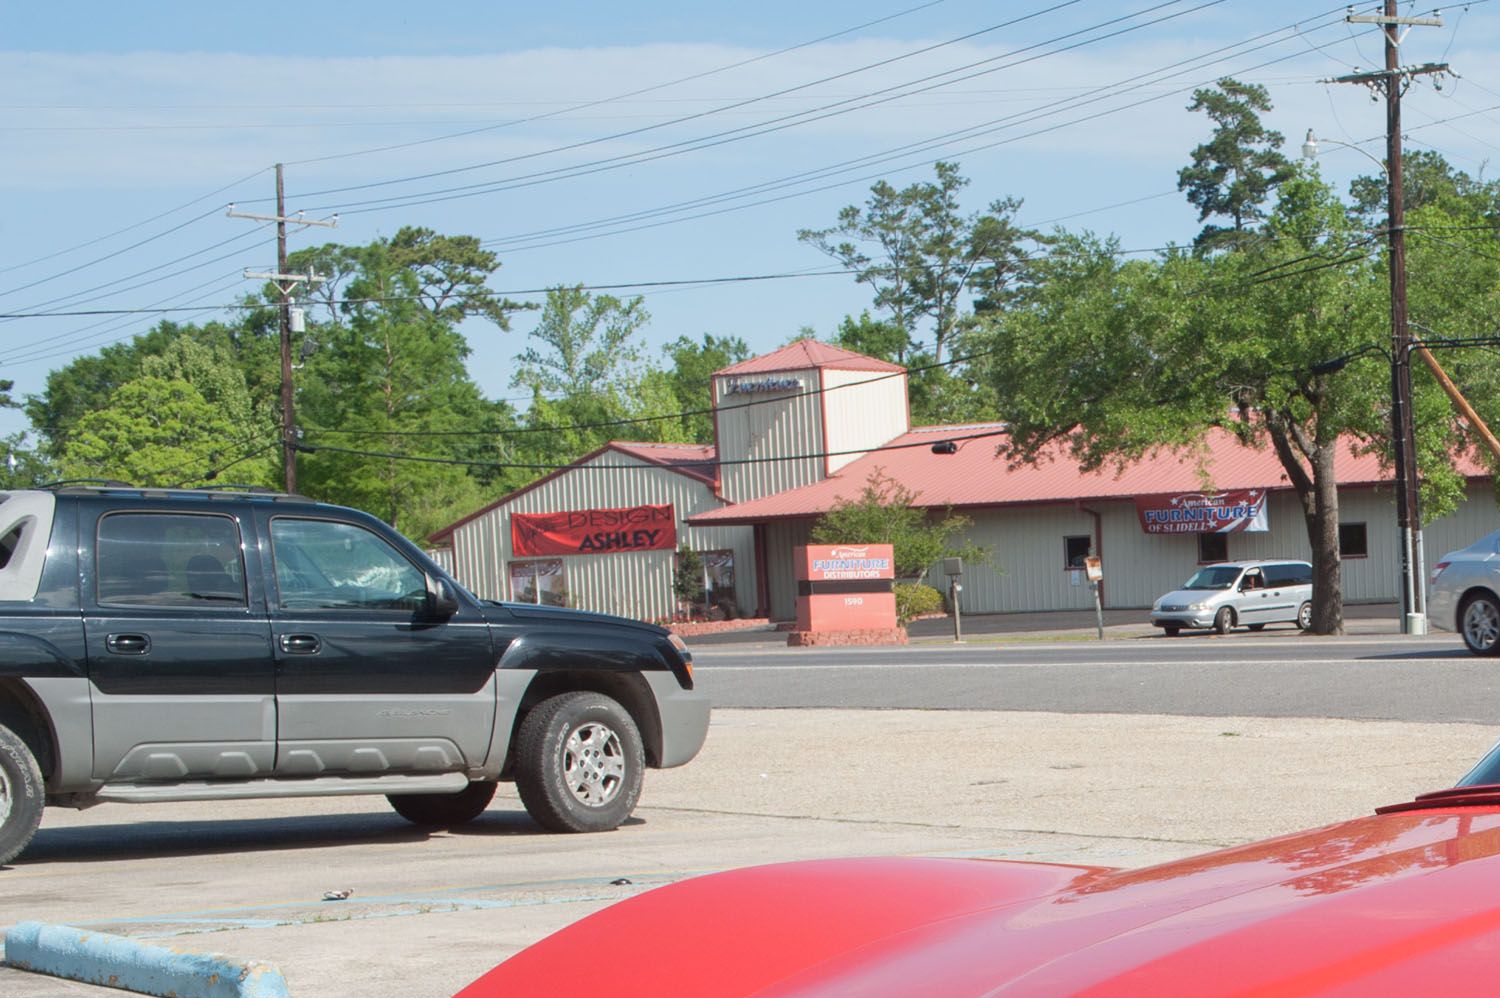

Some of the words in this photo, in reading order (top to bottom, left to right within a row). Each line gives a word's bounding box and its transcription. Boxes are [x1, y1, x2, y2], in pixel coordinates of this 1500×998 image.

[1179, 498, 1225, 508] American
[568, 507, 671, 527] DESIGN
[1145, 506, 1257, 522] FURNITURE
[1148, 523, 1161, 533] OF
[1163, 522, 1208, 532] SLIDELL
[578, 528, 661, 551] ASHLEY
[813, 558, 889, 571] FURNITURE
[823, 570, 880, 579] DISTRIBUTORS
